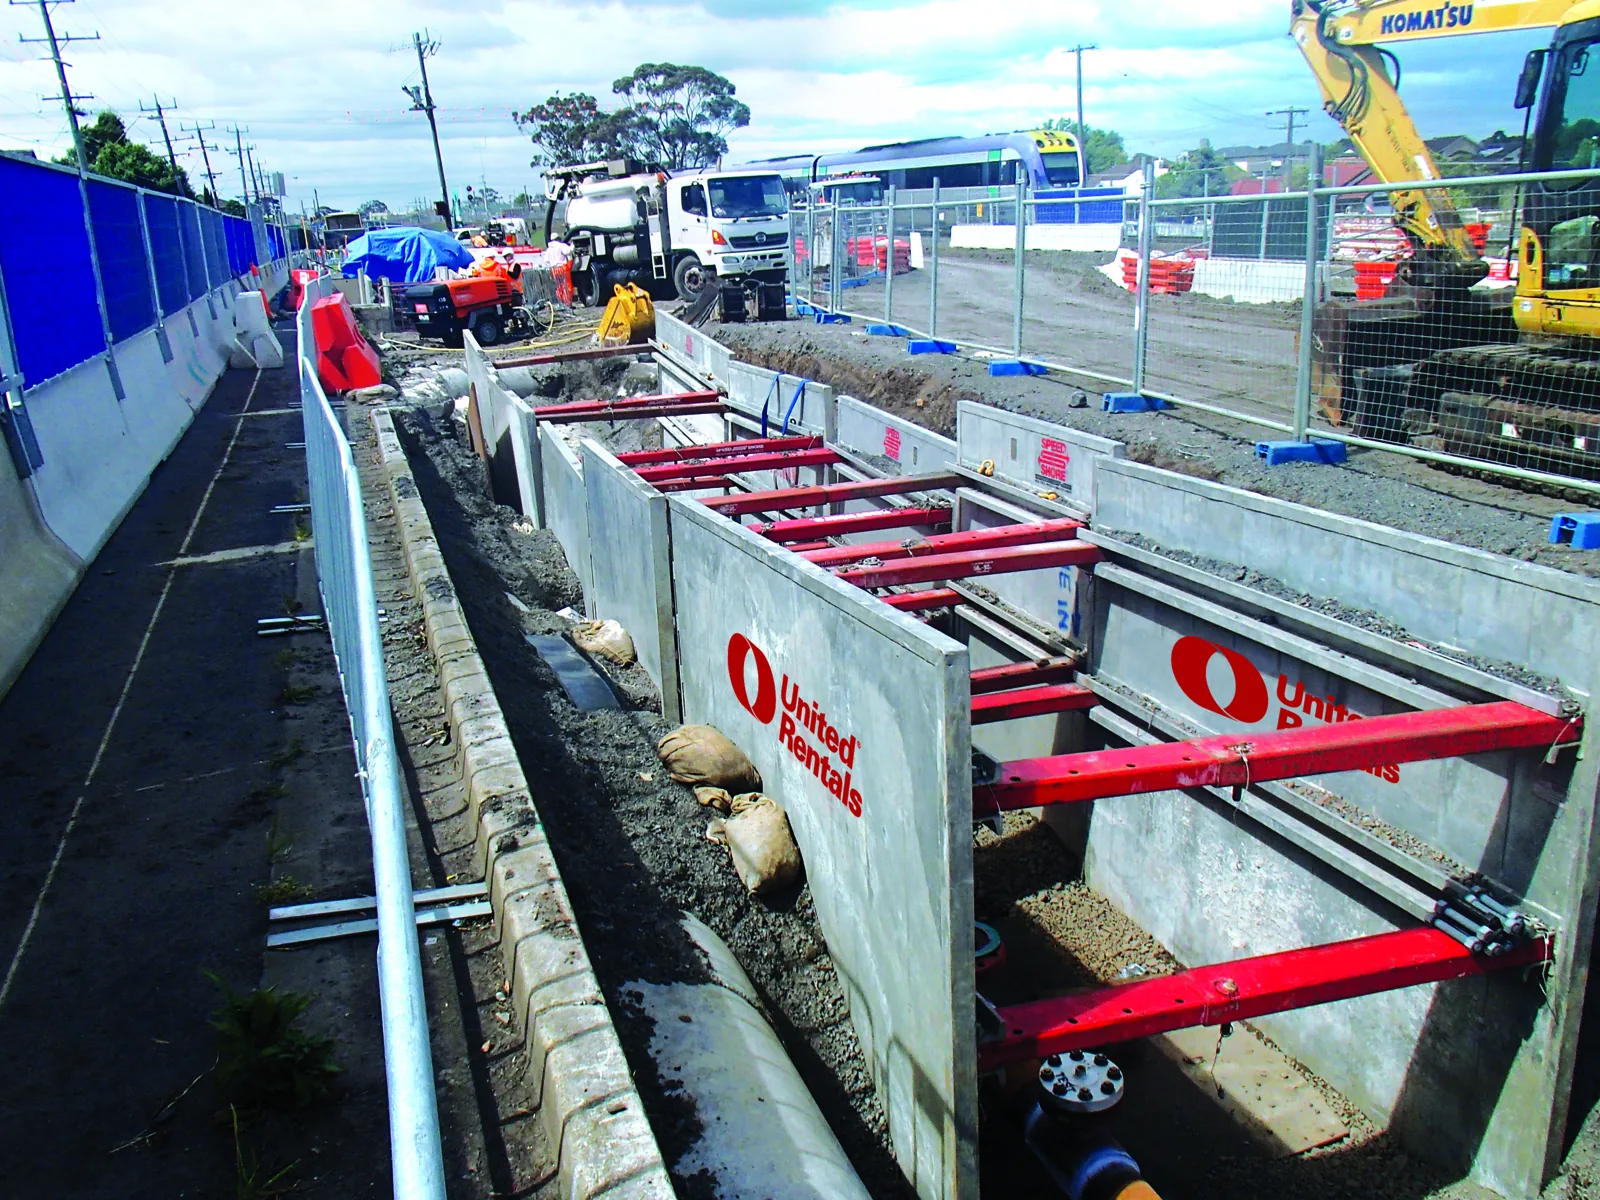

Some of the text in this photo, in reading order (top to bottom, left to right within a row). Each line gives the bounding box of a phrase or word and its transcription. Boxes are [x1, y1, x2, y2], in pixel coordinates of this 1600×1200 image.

[1381, 1, 1473, 34] KOMATSU
[1041, 437, 1067, 453] SPEED
[1040, 463, 1066, 482] SHORE
[1276, 673, 1364, 724] Unit
[781, 673, 857, 770] United
[778, 710, 863, 819] Rentals
